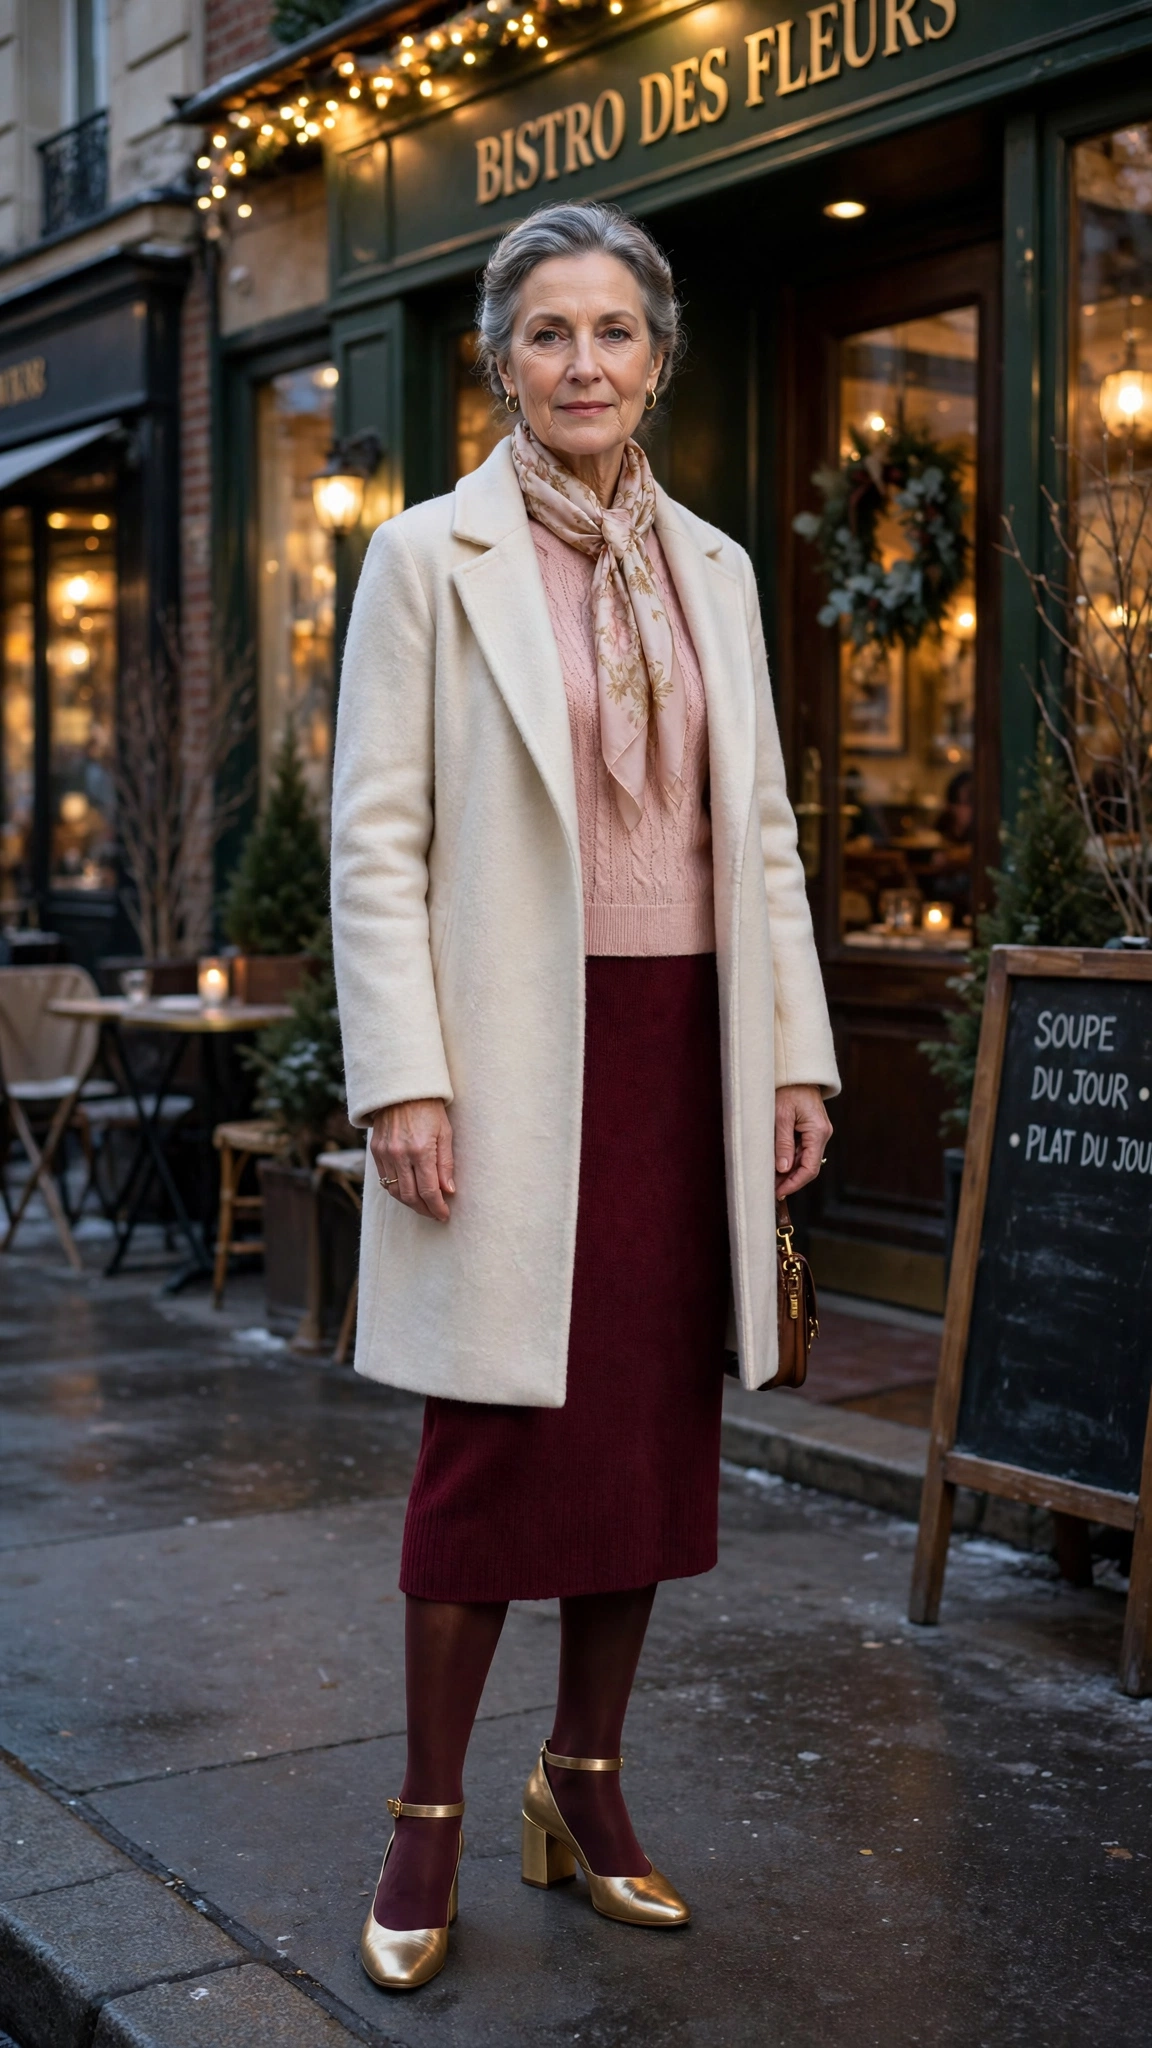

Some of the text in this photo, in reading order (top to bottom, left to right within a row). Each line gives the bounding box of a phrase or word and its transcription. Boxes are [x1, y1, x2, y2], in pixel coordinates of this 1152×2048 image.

[475, 88, 627, 205] BISTRO
[638, 45, 729, 147] DES
[1034, 1011, 1117, 1051] SOUPE
[1031, 1065, 1129, 1111] DU JOUR
[1025, 1124, 1152, 1175] PLAT DU JOU
